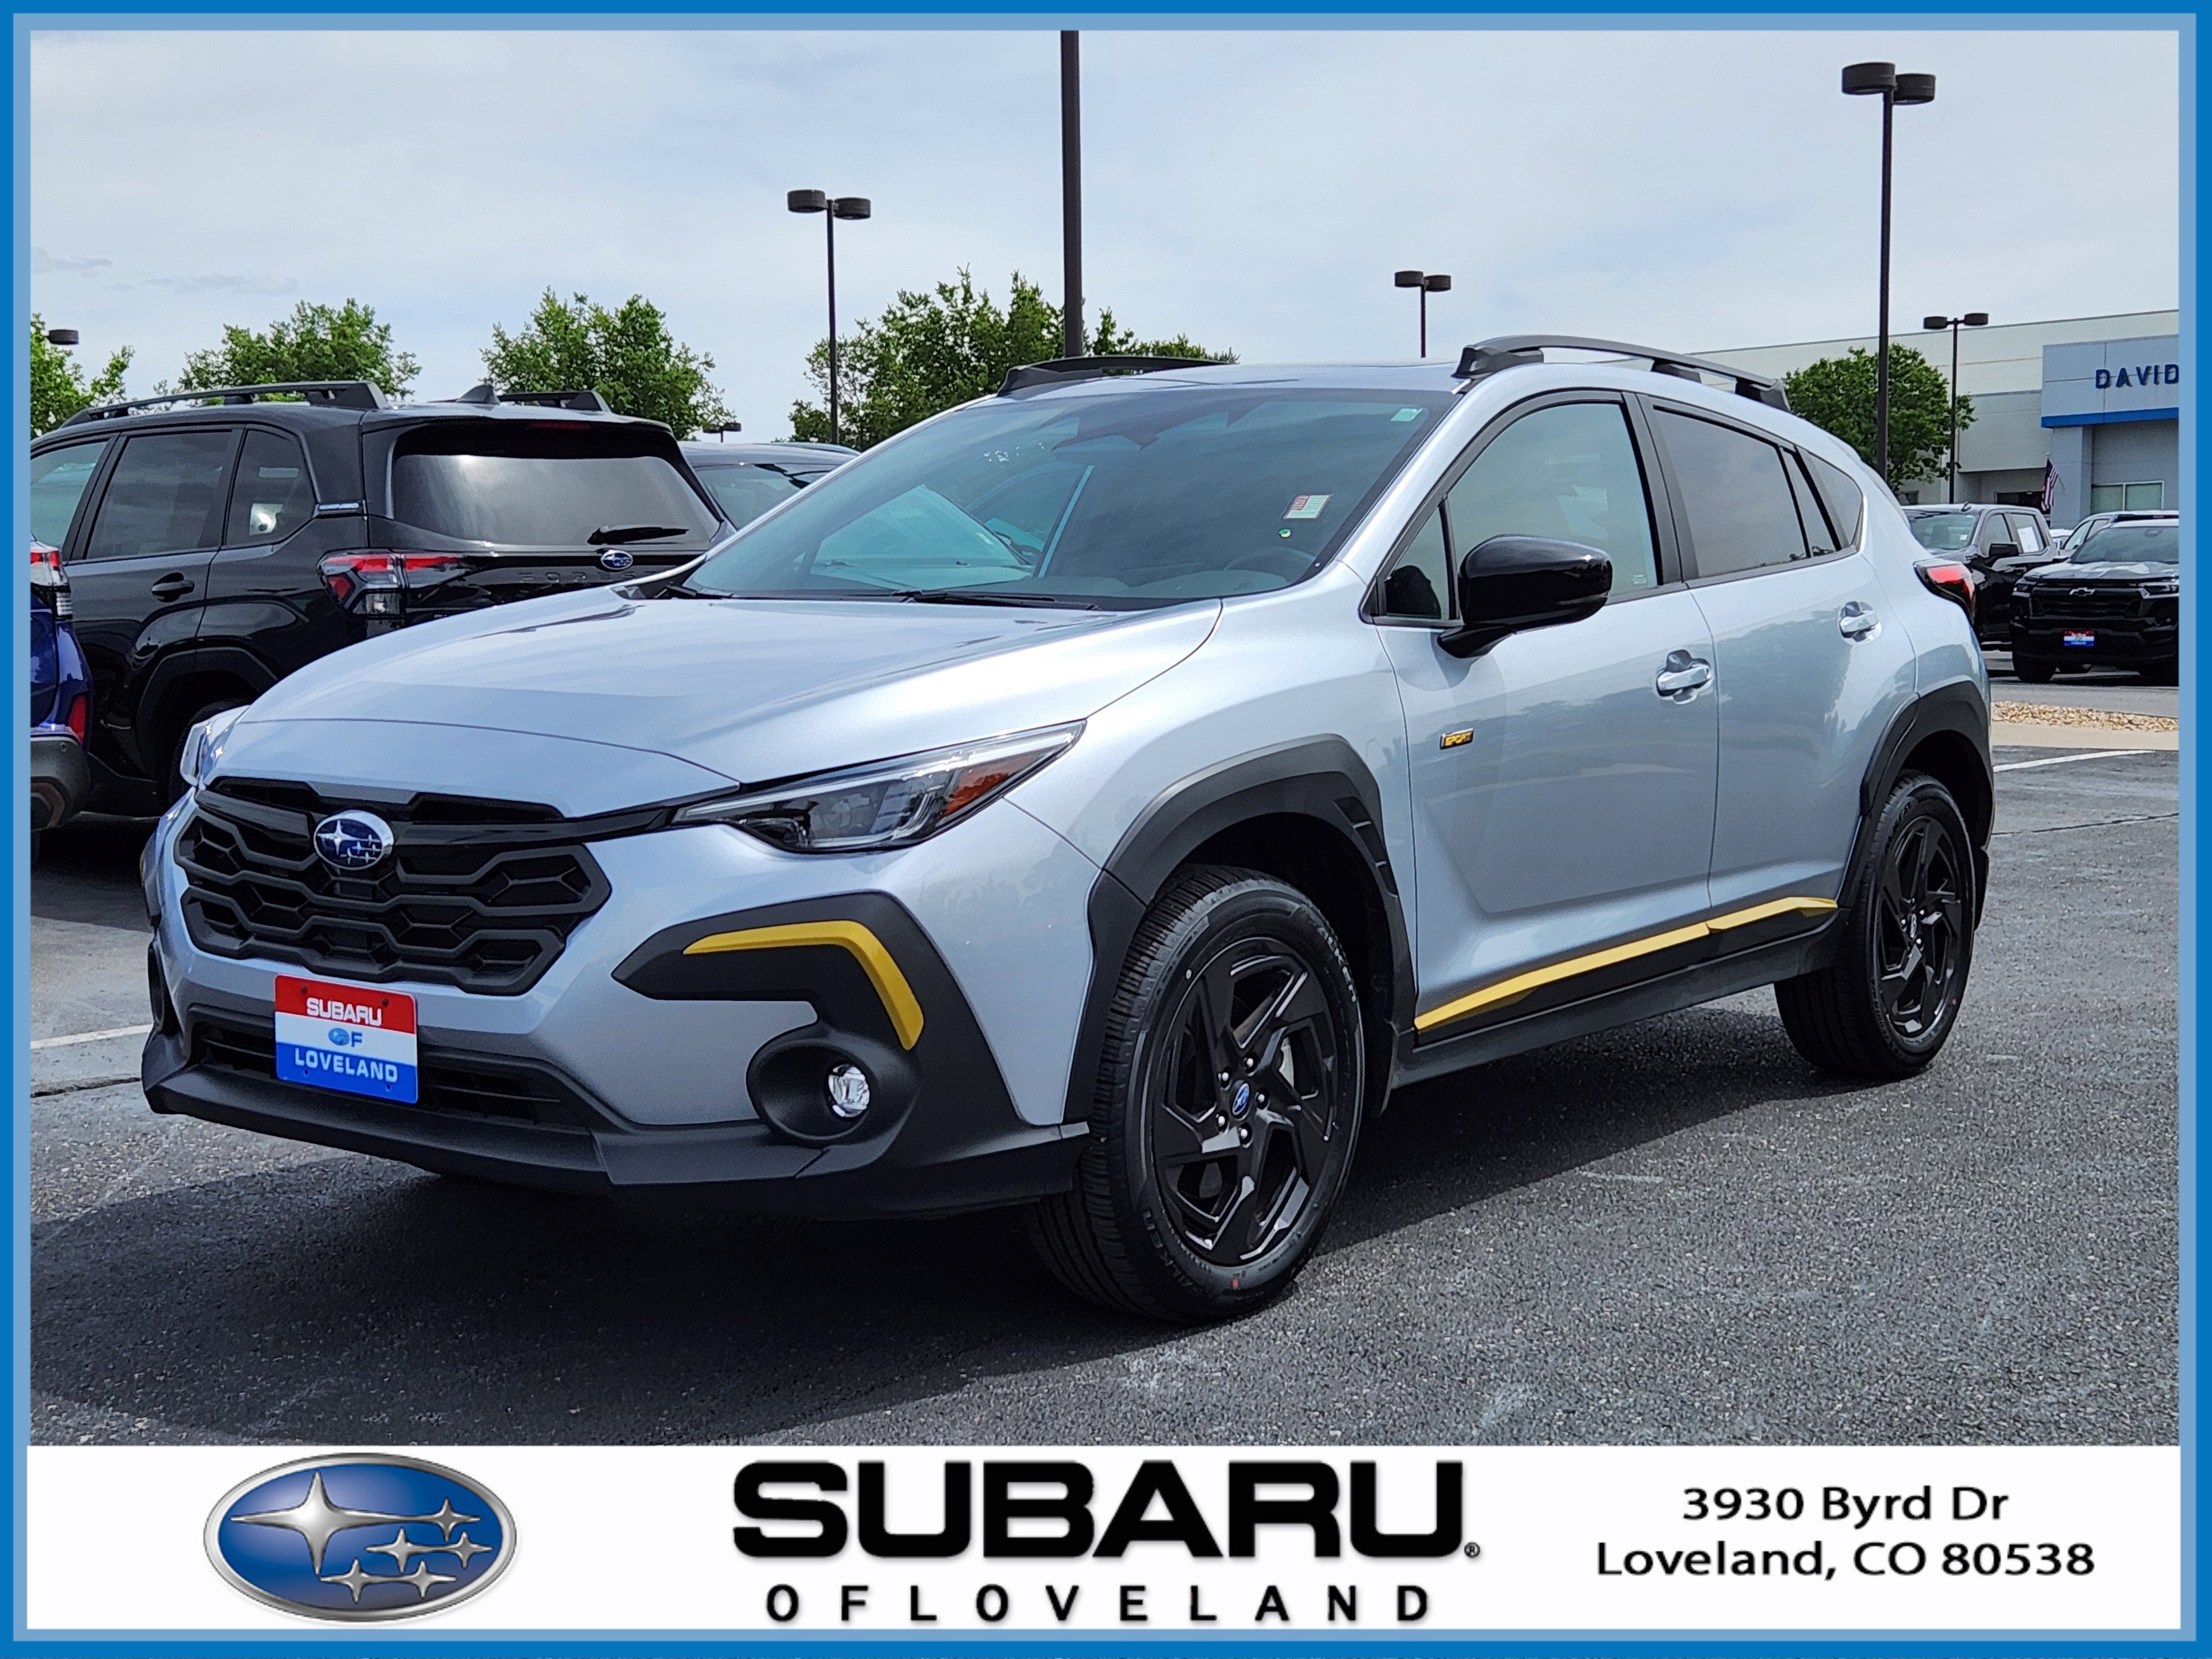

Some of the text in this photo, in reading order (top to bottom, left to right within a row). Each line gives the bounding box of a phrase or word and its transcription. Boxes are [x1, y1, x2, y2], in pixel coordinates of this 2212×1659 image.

[2095, 364, 2179, 389] DAVID
[1444, 731, 1472, 747] SPORT
[306, 997, 383, 1027] SUBARU
[294, 1048, 399, 1083] LOVELAND
